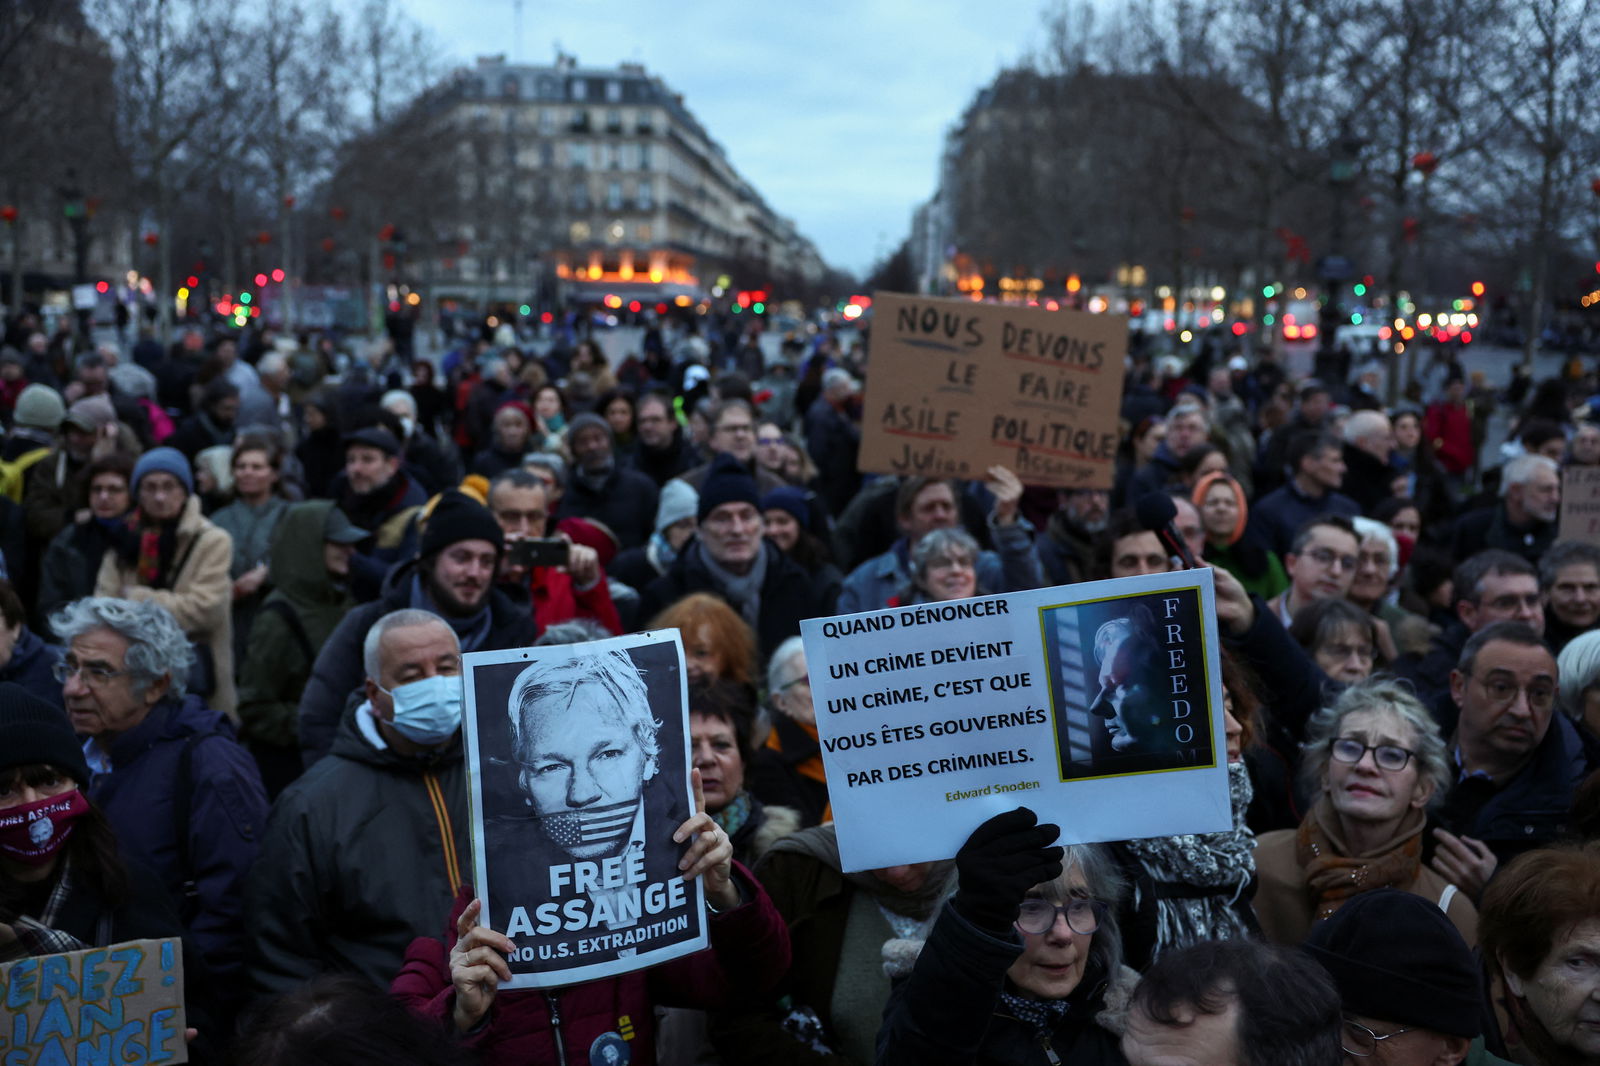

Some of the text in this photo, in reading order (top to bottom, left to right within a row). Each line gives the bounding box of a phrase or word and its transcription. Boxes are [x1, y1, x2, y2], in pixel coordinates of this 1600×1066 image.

[896, 304, 1107, 370] NOUS DEVONS
[945, 360, 978, 385] LE
[822, 599, 1010, 639] QUAND DÉNONCER
[827, 696, 858, 714] UN
[933, 677, 984, 699] C’EST
[989, 672, 1032, 692] QUE
[829, 662, 860, 680] UN
[823, 705, 1048, 754] VOUS ÊTES GOUVERNÉS
[846, 768, 884, 788] PAR
[888, 762, 924, 782] DES
[945, 778, 1041, 803] Edward Snoden
[549, 851, 648, 898] FREE
[505, 875, 688, 939] ASSANGE
[507, 913, 689, 963] NO U.S. EXTRADITION
[0, 945, 147, 1012] EREZ
[0, 995, 126, 1048] IAN
